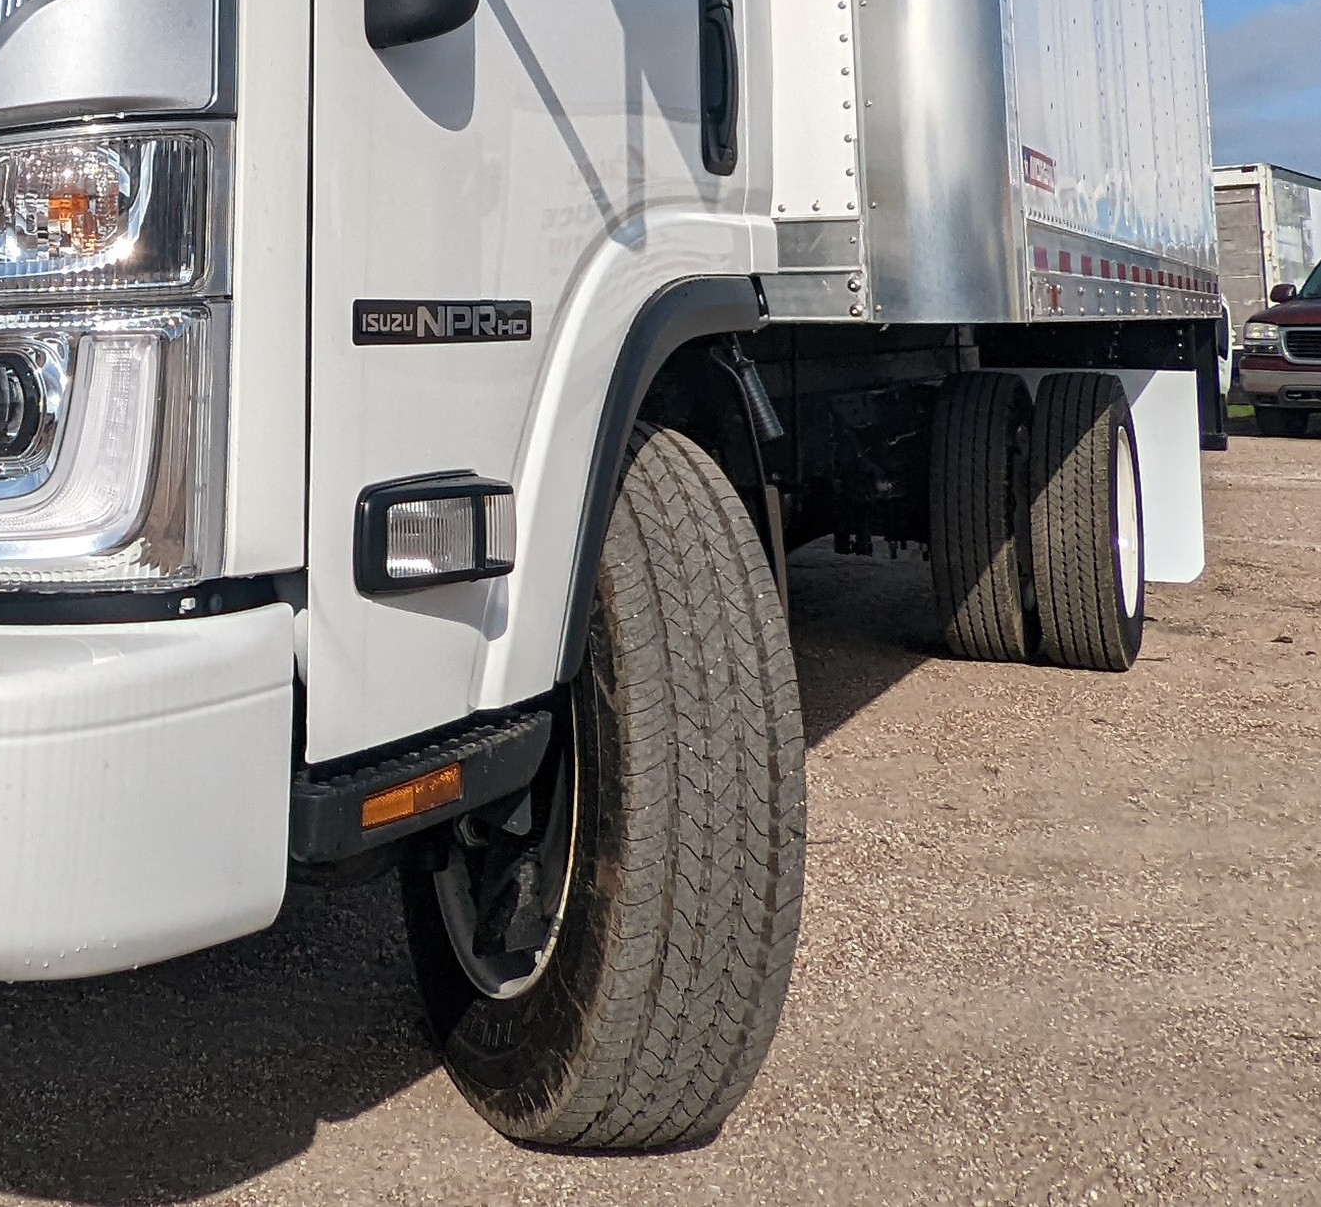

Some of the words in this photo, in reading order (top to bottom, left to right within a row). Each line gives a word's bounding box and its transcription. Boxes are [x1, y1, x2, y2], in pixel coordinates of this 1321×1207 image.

[362, 312, 414, 333] ISUZU
[416, 305, 497, 338] NPR
[497, 318, 528, 335] HD
